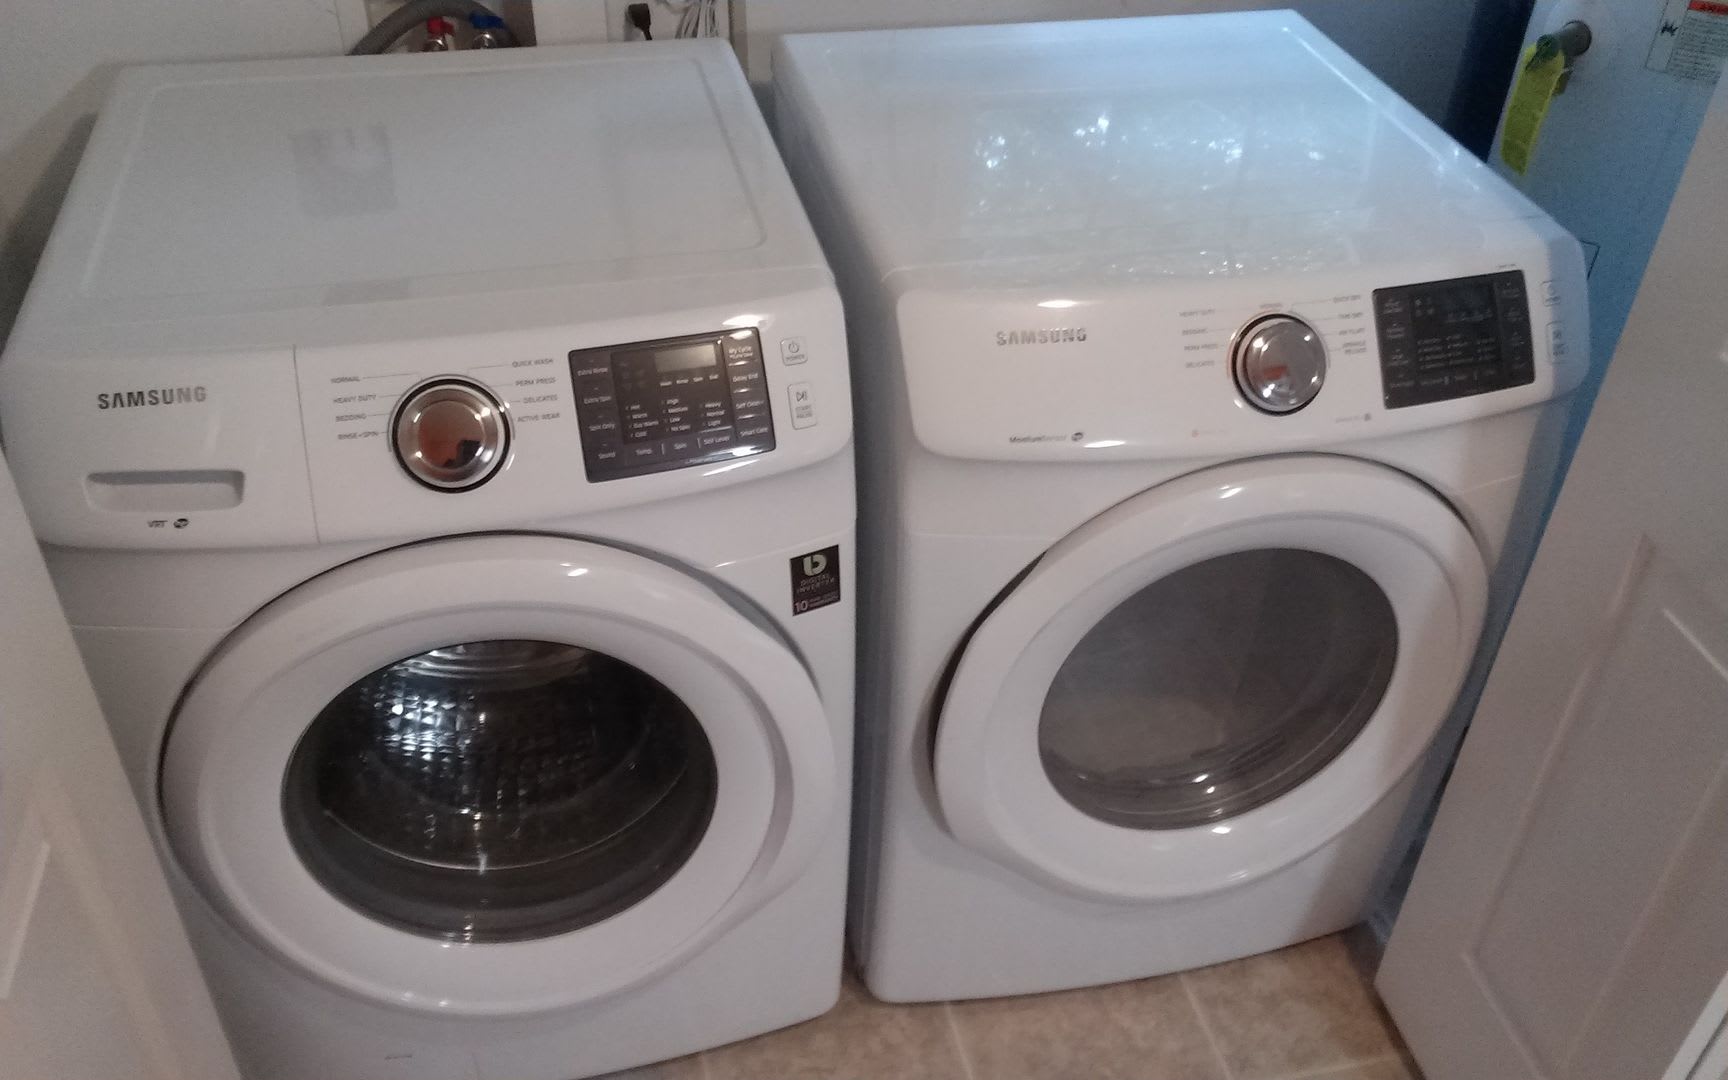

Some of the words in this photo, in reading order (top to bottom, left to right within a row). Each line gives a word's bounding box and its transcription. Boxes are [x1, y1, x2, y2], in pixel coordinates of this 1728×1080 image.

[996, 328, 1087, 346] SAMSUNG
[512, 360, 532, 368] QUICK
[536, 376, 556, 384] PRESS
[97, 386, 206, 409] SAMSUNG
[358, 394, 376, 402] DUTY
[794, 600, 808, 613] 10
